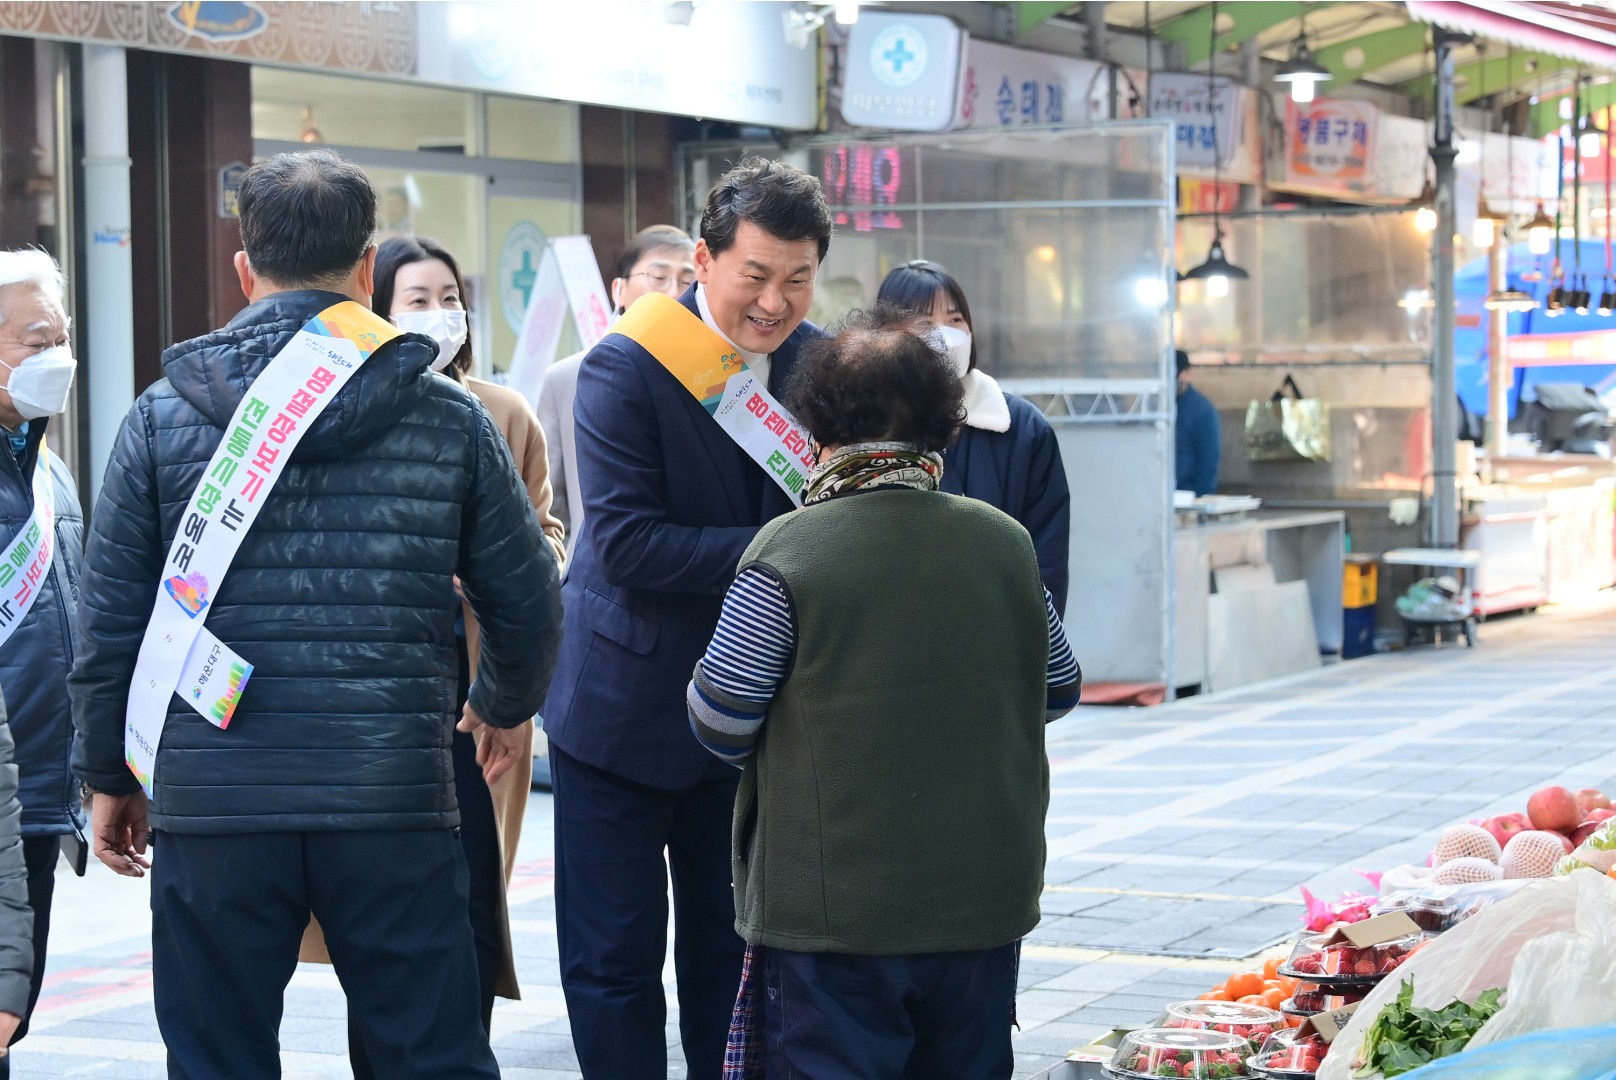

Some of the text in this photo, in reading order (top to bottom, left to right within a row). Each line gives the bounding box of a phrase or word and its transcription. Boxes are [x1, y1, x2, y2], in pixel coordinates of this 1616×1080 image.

[172, 396, 271, 574] 전통시장에서
[219, 365, 337, 532] 명절장보기는
[197, 643, 222, 686] 해운대구
